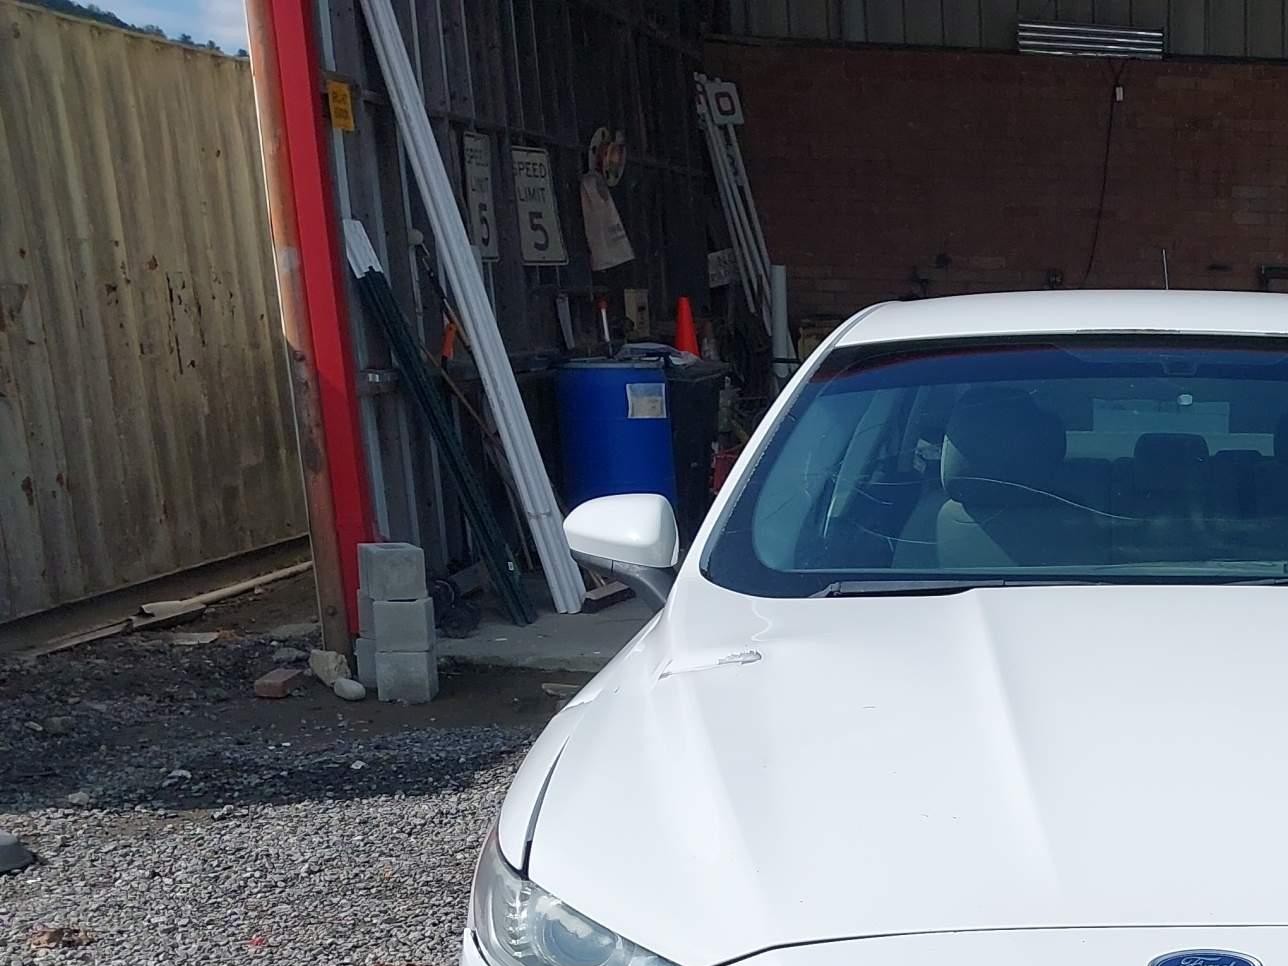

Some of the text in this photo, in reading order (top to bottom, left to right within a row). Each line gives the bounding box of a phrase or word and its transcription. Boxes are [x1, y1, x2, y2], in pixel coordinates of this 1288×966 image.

[512, 160, 547, 179] SPEED
[518, 186, 546, 203] LIMIT
[478, 202, 490, 248] 5
[528, 211, 549, 251] 5
